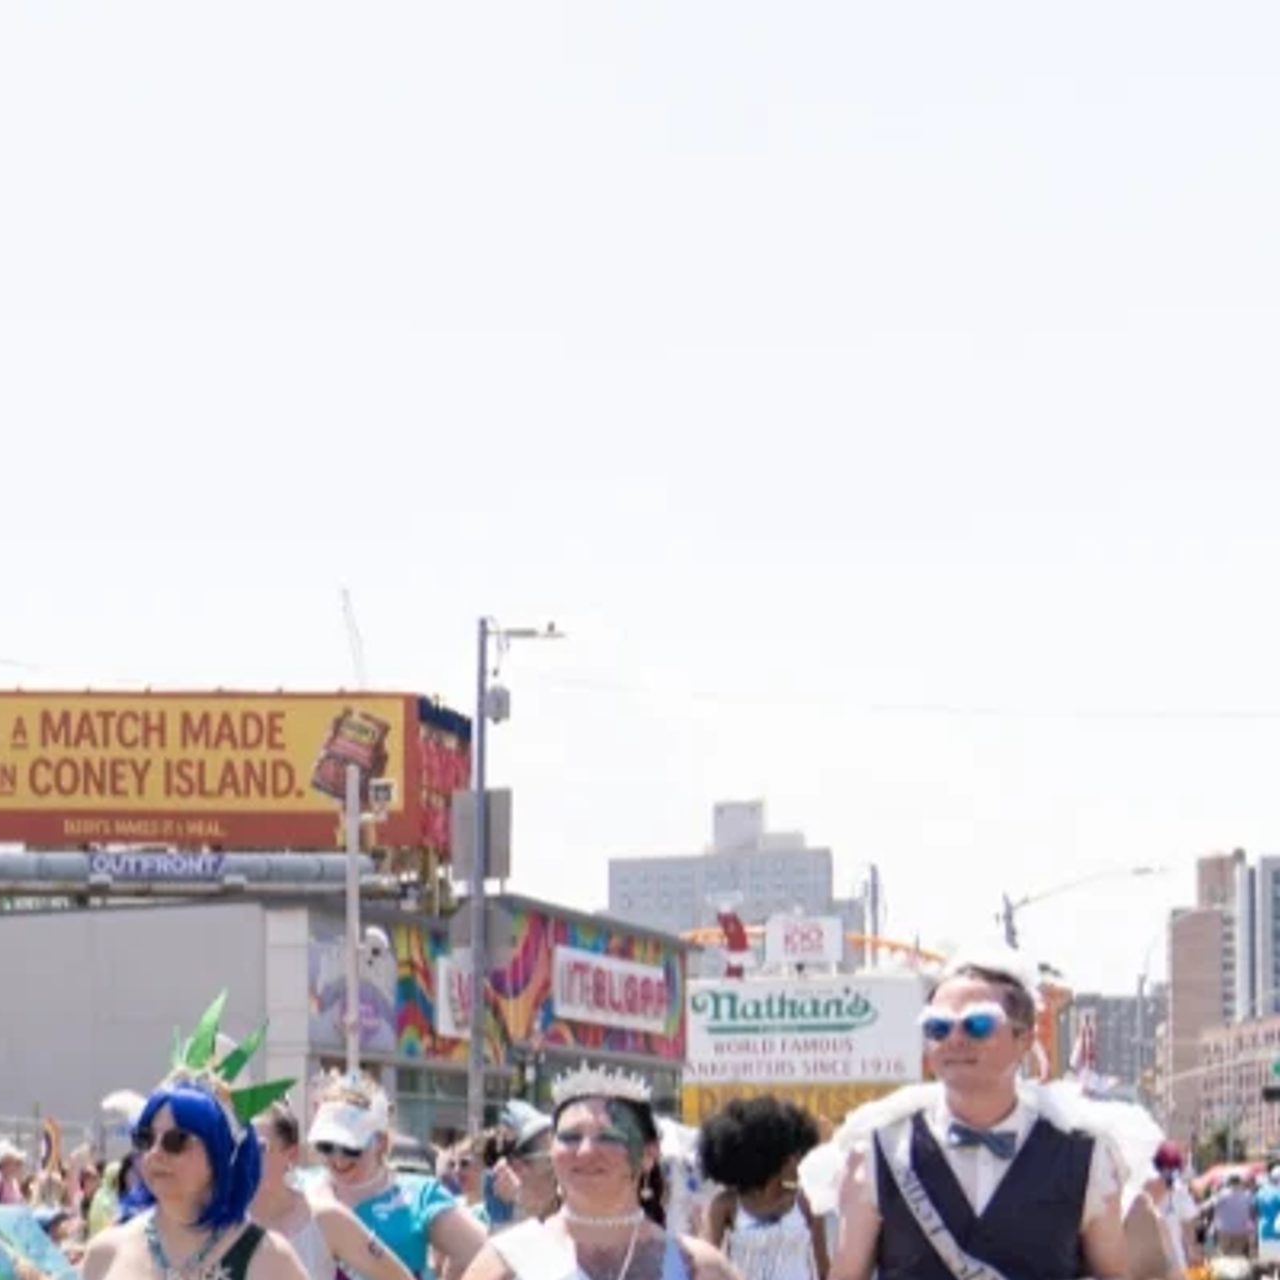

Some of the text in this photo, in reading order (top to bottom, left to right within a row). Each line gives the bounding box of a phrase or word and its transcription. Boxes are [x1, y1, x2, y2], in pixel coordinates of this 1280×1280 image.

[11, 710, 286, 750] A MATCH MADE
[29, 758, 152, 796] CONEY
[164, 758, 305, 798] ISLAND.
[691, 986, 874, 1021] Nathan's
[714, 1037, 853, 1054] WORLD FAMOUS
[803, 1059, 850, 1076] SINCE
